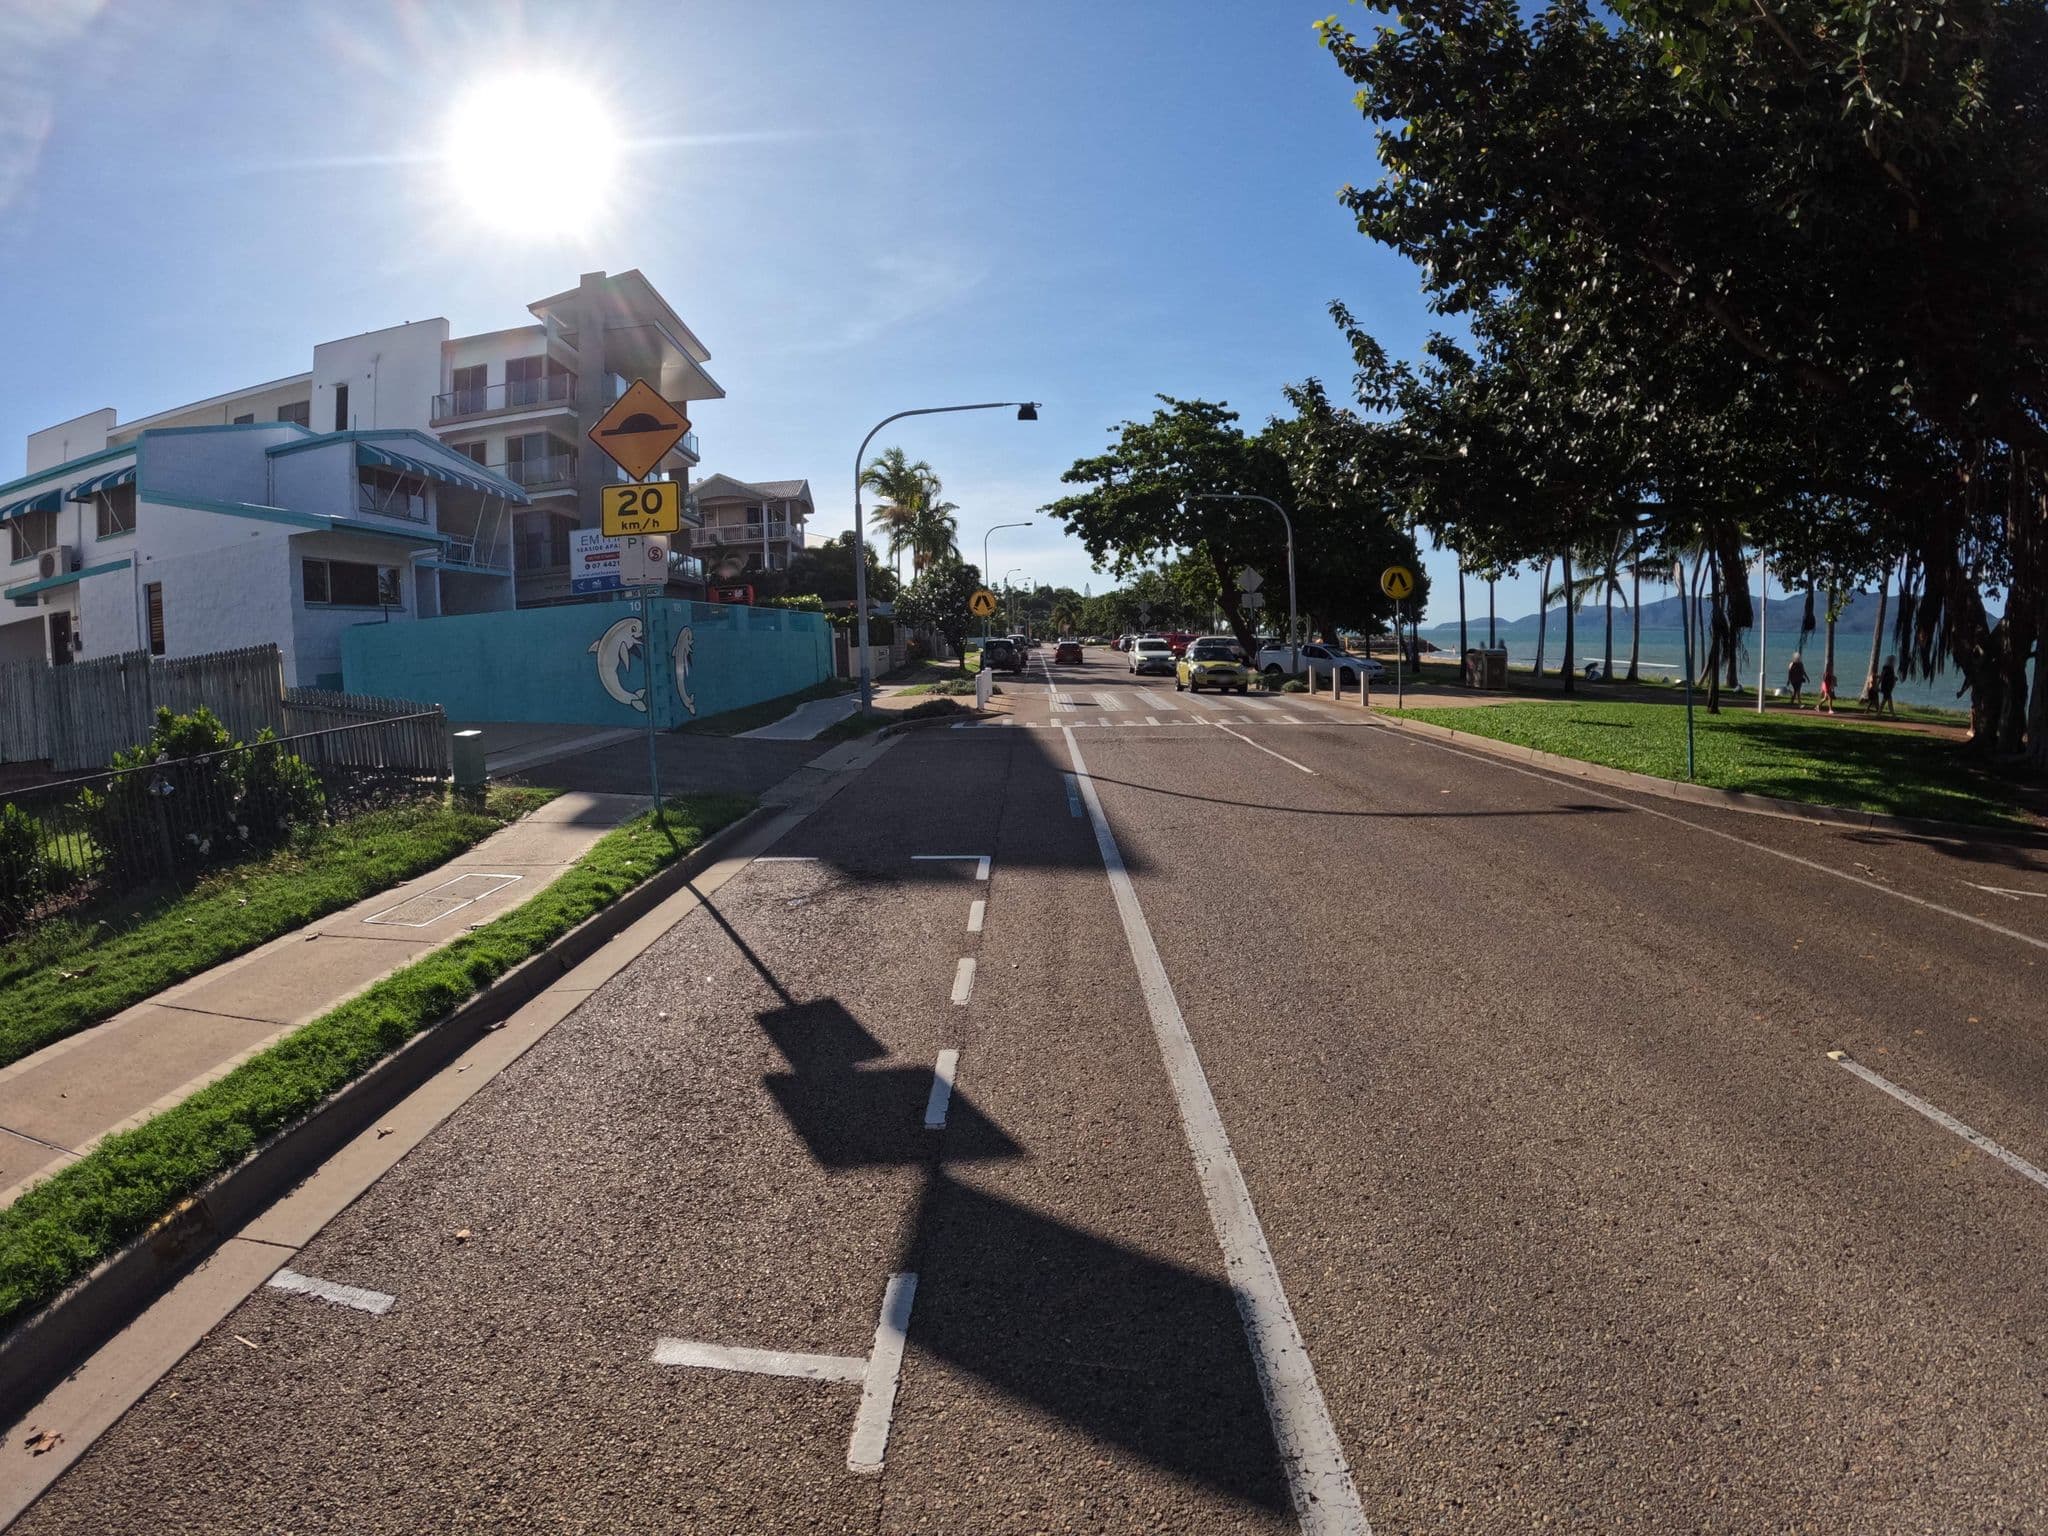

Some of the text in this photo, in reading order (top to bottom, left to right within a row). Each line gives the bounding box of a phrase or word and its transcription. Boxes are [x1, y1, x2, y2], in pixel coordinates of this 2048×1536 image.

[618, 488, 662, 516] 20
[621, 518, 660, 530] km/h
[627, 538, 637, 548] P
[630, 601, 641, 612] 10
